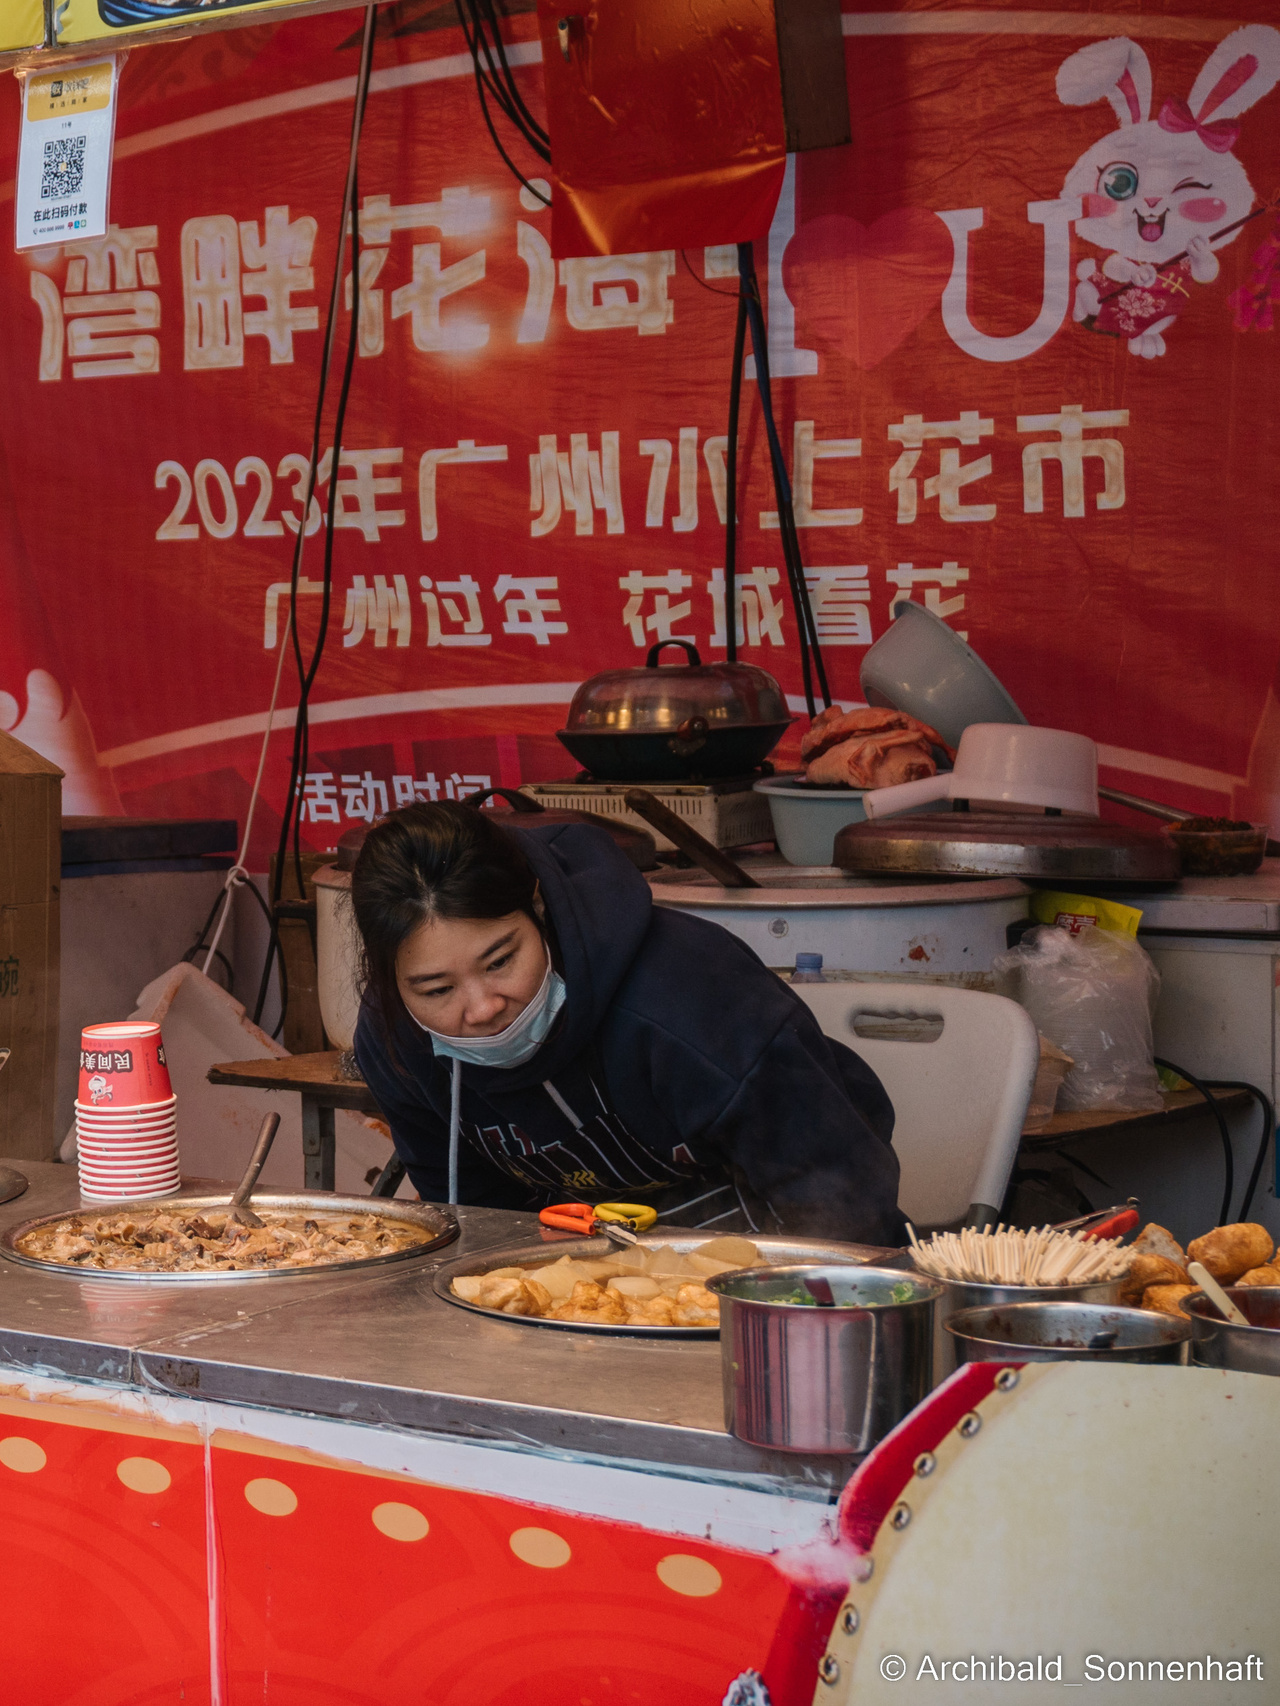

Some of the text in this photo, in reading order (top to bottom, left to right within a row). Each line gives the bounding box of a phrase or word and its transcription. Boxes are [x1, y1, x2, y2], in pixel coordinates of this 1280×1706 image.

[33, 202, 88, 223] 在此扫码付款
